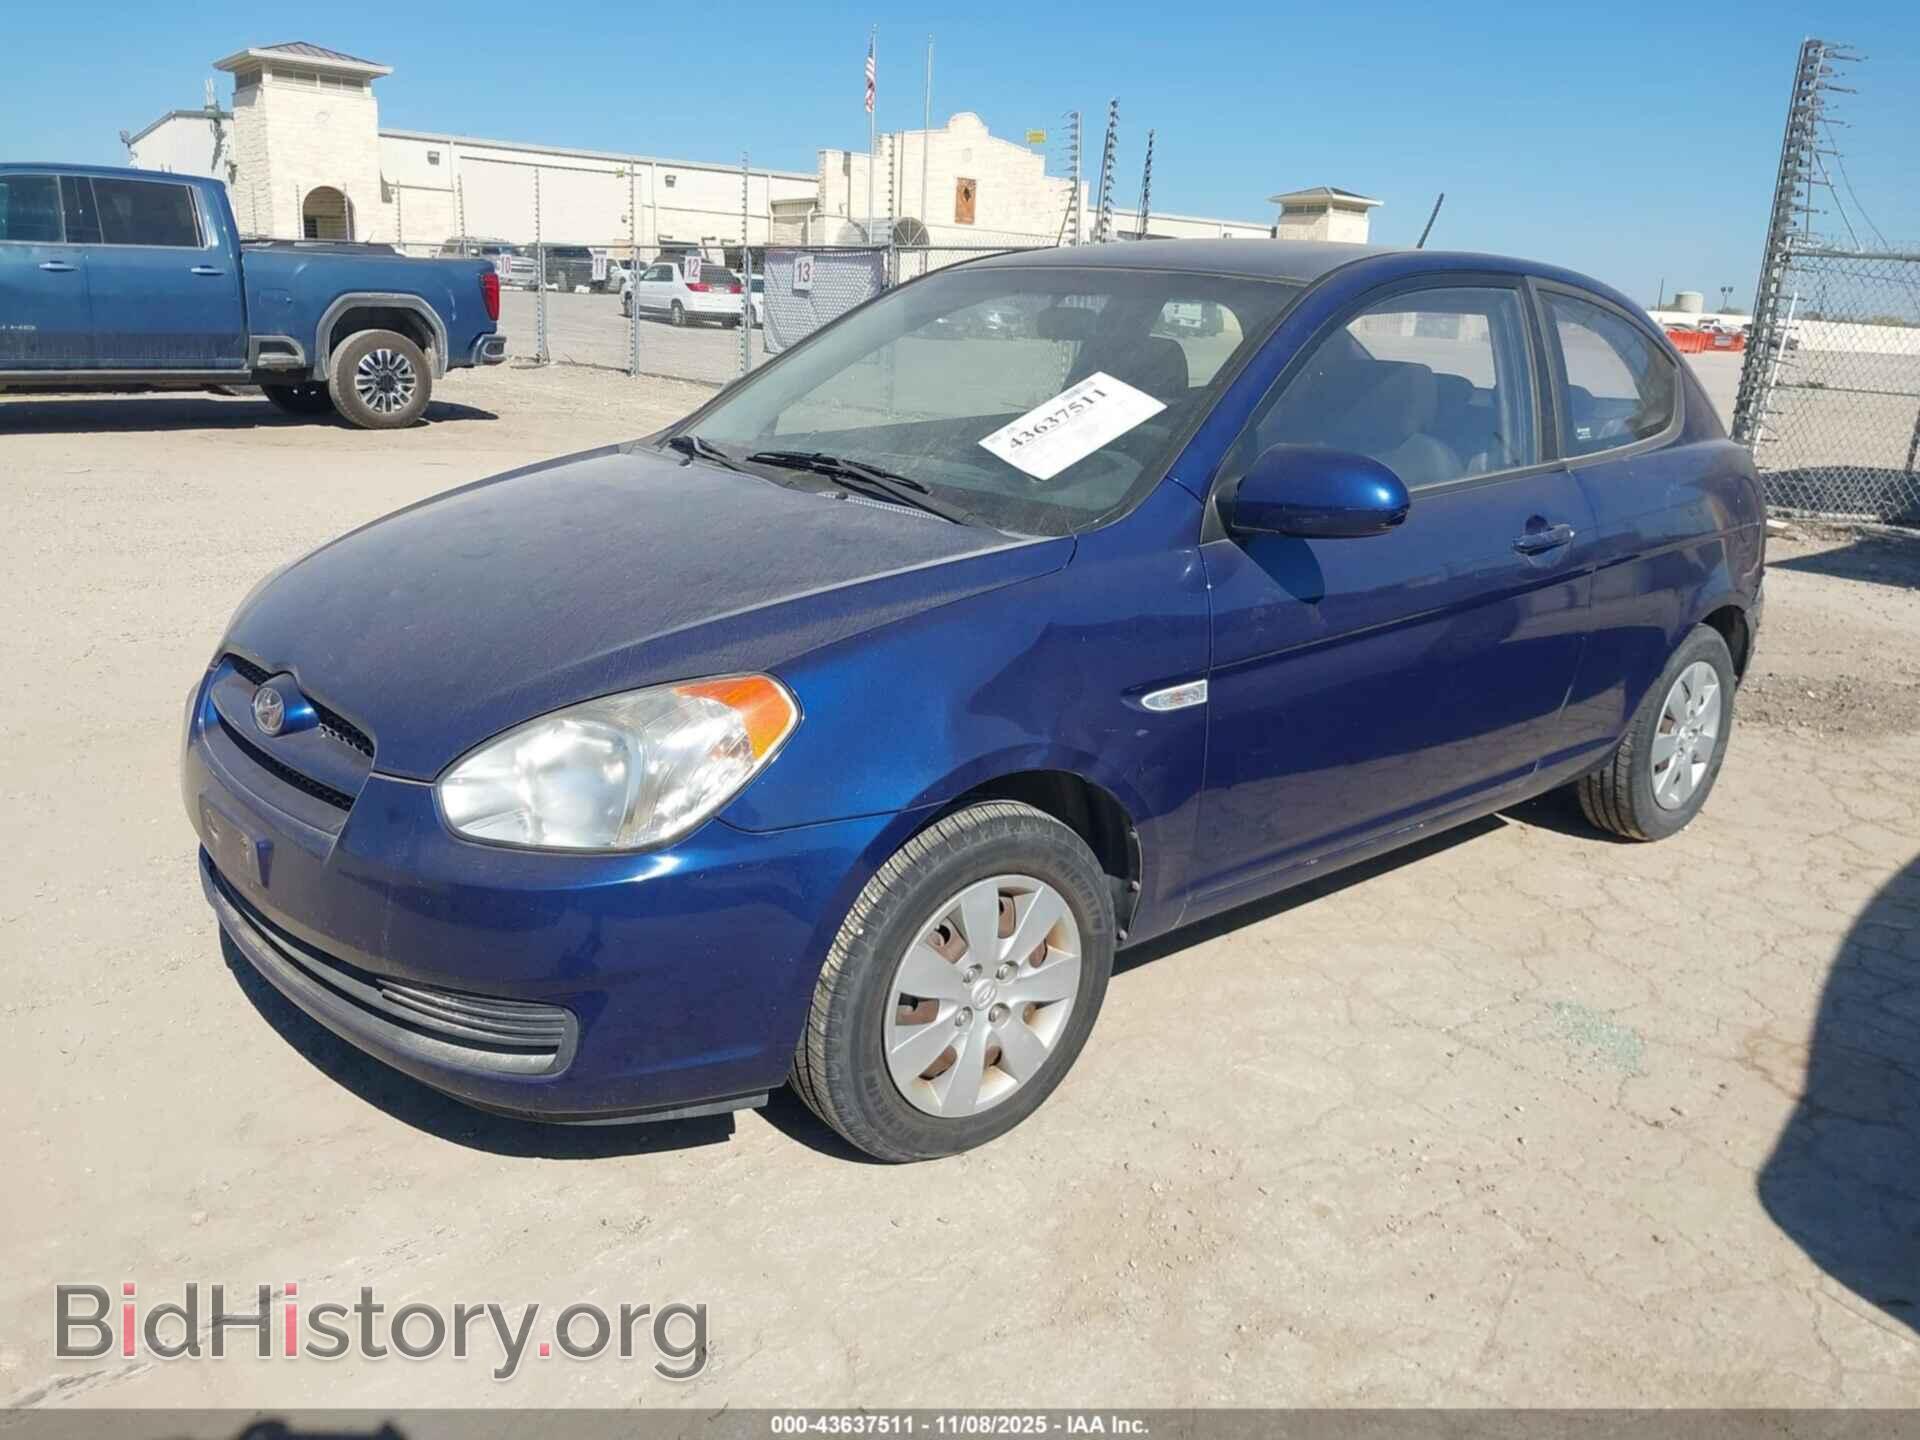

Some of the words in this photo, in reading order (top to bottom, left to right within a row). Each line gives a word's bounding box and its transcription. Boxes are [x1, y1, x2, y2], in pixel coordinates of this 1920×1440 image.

[501, 256, 511, 274] 10
[595, 257, 605, 275] 11
[687, 258, 699, 277] 12
[798, 262, 811, 282] 13
[1010, 388, 1107, 448] 43637511
